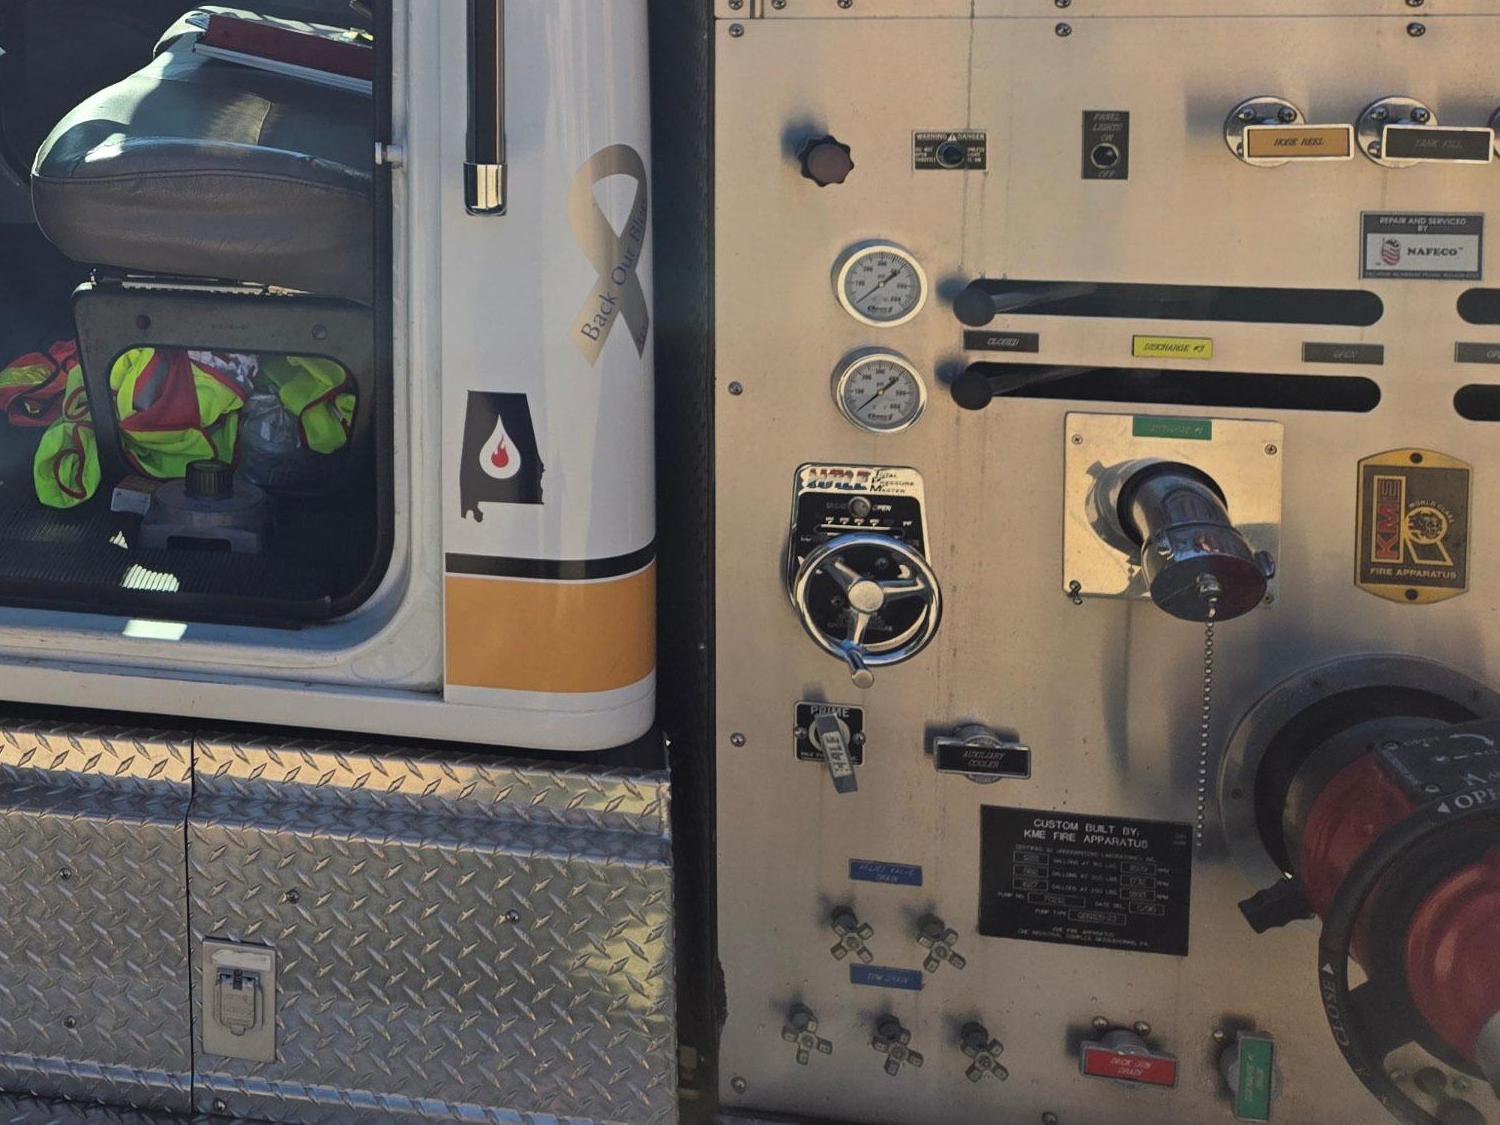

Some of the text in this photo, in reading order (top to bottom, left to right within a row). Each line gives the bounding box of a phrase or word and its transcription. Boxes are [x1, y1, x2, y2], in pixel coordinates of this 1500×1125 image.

[1274, 137, 1324, 147] HOSE REEL
[1380, 217, 1467, 225] REPAIR AND SERVICED
[1407, 247, 1458, 257] NAFECO
[580, 291, 617, 341] Back
[611, 250, 636, 286] Our
[987, 337, 1019, 347] CLOSED
[1143, 343, 1189, 353] DISCHARGE
[1377, 479, 1400, 560] KME
[1370, 567, 1457, 580] FIRE APPARATUS
[811, 705, 850, 718] PRIME
[1033, 818, 1079, 830] CUSTOM
[1085, 824, 1115, 835] BUILT
[1023, 829, 1149, 849] KME FIRE APPARATUS
[1322, 978, 1350, 1047] CLOSE
